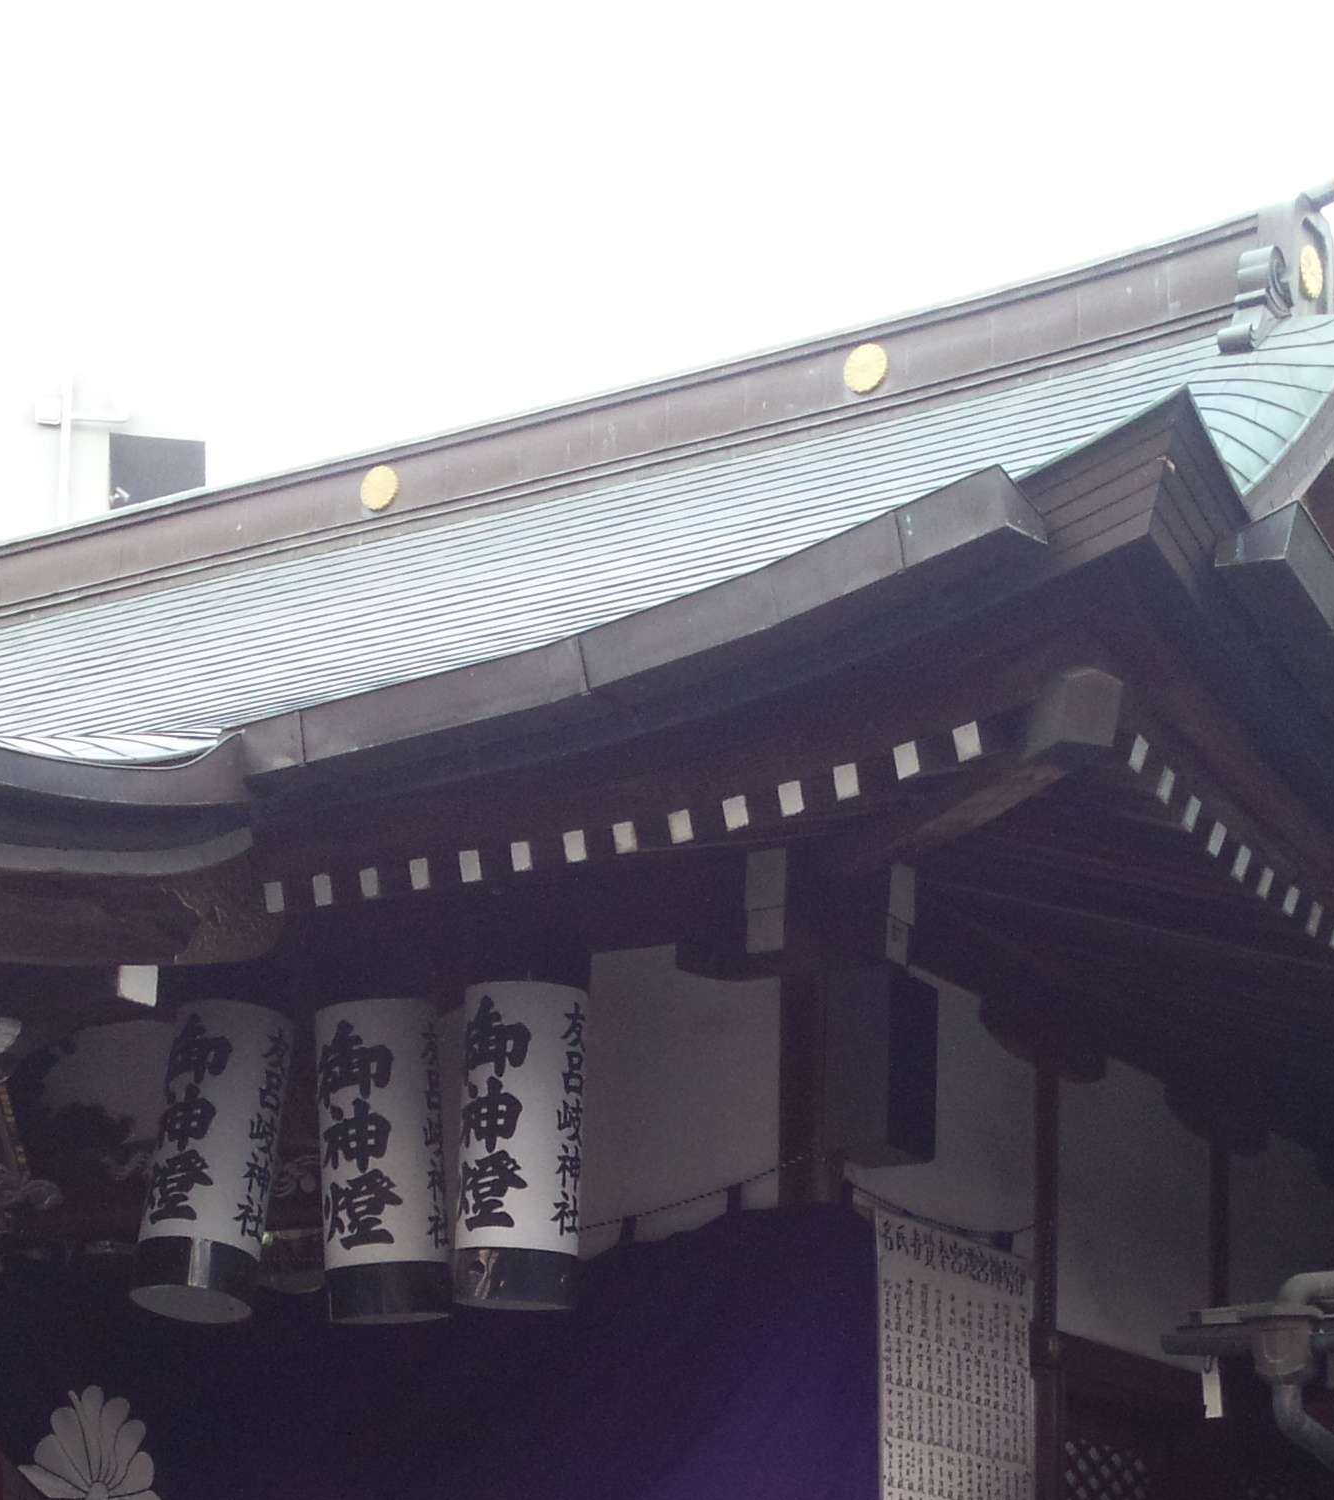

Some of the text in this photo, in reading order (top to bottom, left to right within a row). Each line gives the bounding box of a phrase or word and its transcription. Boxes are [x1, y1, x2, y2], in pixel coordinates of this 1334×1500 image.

[318, 1019, 405, 1251] 御神燈
[550, 1002, 586, 1239] 友呂岐神社
